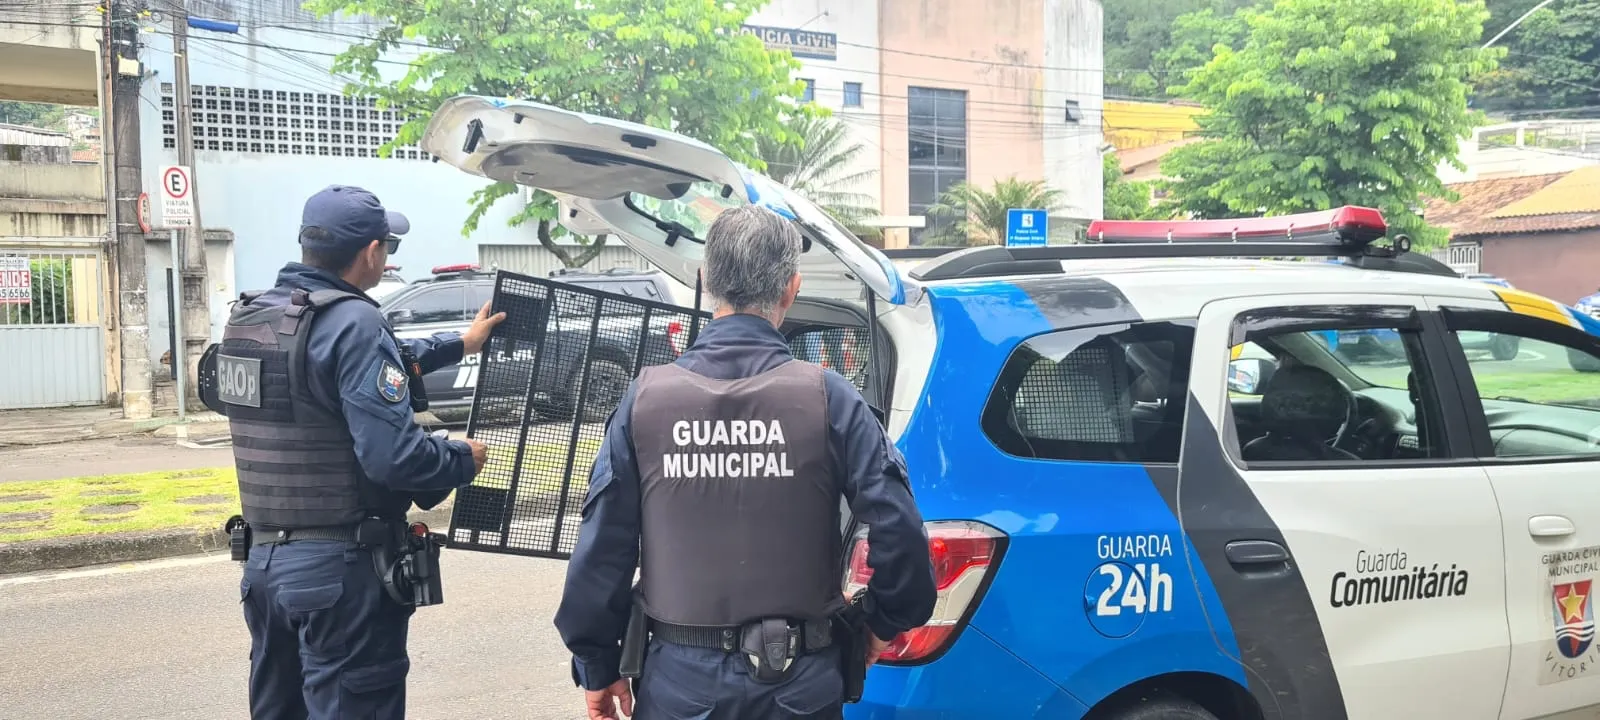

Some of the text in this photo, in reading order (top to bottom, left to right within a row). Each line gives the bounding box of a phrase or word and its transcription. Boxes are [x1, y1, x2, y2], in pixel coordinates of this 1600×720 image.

[171, 174, 181, 191] E
[218, 360, 256, 401] GAOp
[672, 419, 786, 446] GUARDA
[663, 452, 794, 478] MUNICIPAL
[1097, 534, 1173, 559] GUARDA
[1541, 551, 1581, 565] GUARDA
[1356, 548, 1408, 574] Guarda
[1548, 562, 1599, 577] MUNICIPAL
[1097, 562, 1173, 617] 24h
[1330, 563, 1469, 608] Comunitária
